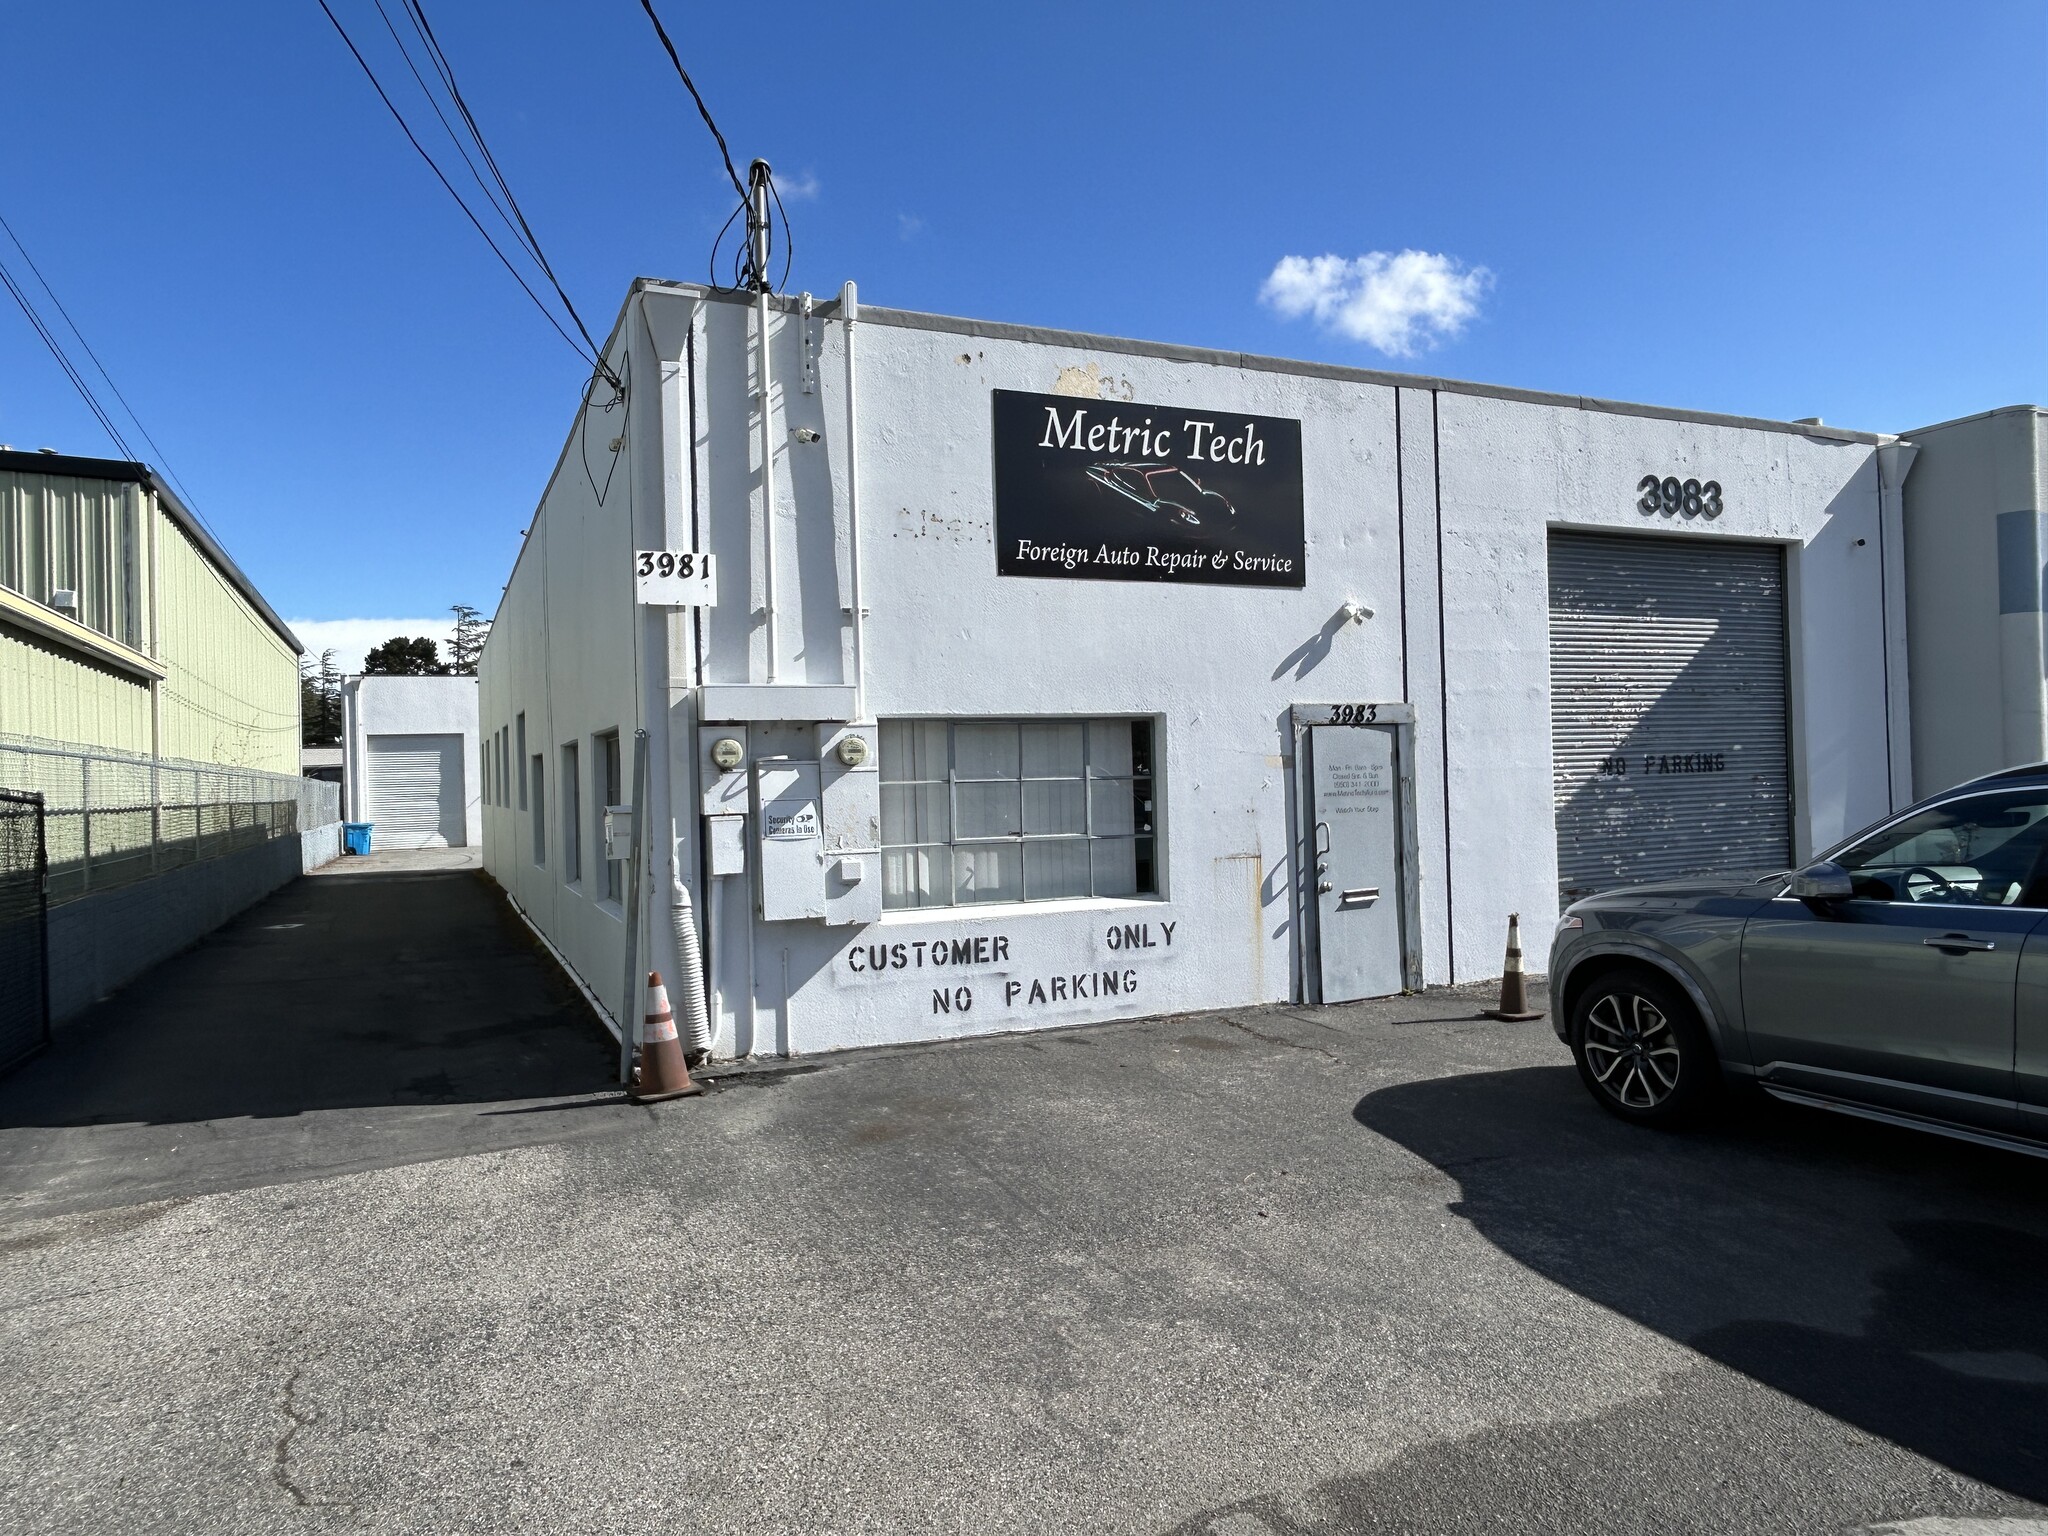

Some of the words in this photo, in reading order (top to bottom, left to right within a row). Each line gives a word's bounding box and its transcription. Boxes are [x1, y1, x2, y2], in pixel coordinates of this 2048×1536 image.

[1038, 406, 1171, 457] Metric
[1183, 419, 1267, 466] Tech
[1638, 474, 1723, 521] 3983
[637, 551, 710, 580] 3981
[1016, 539, 1089, 570] Foreign
[1093, 543, 1140, 566] Auto
[1145, 546, 1206, 573] Repair
[1211, 549, 1229, 570] &
[1233, 550, 1293, 573] Service
[1328, 703, 1377, 725] 3983
[1602, 756, 1626, 776] NO
[1645, 753, 1726, 775] PARKING
[768, 815, 795, 825] Security
[803, 825, 815, 834] Use
[848, 935, 1010, 972] CUSTOMER
[1106, 921, 1177, 950] ONLY
[932, 986, 973, 1014] NO
[1005, 969, 1139, 1007] PARKING
